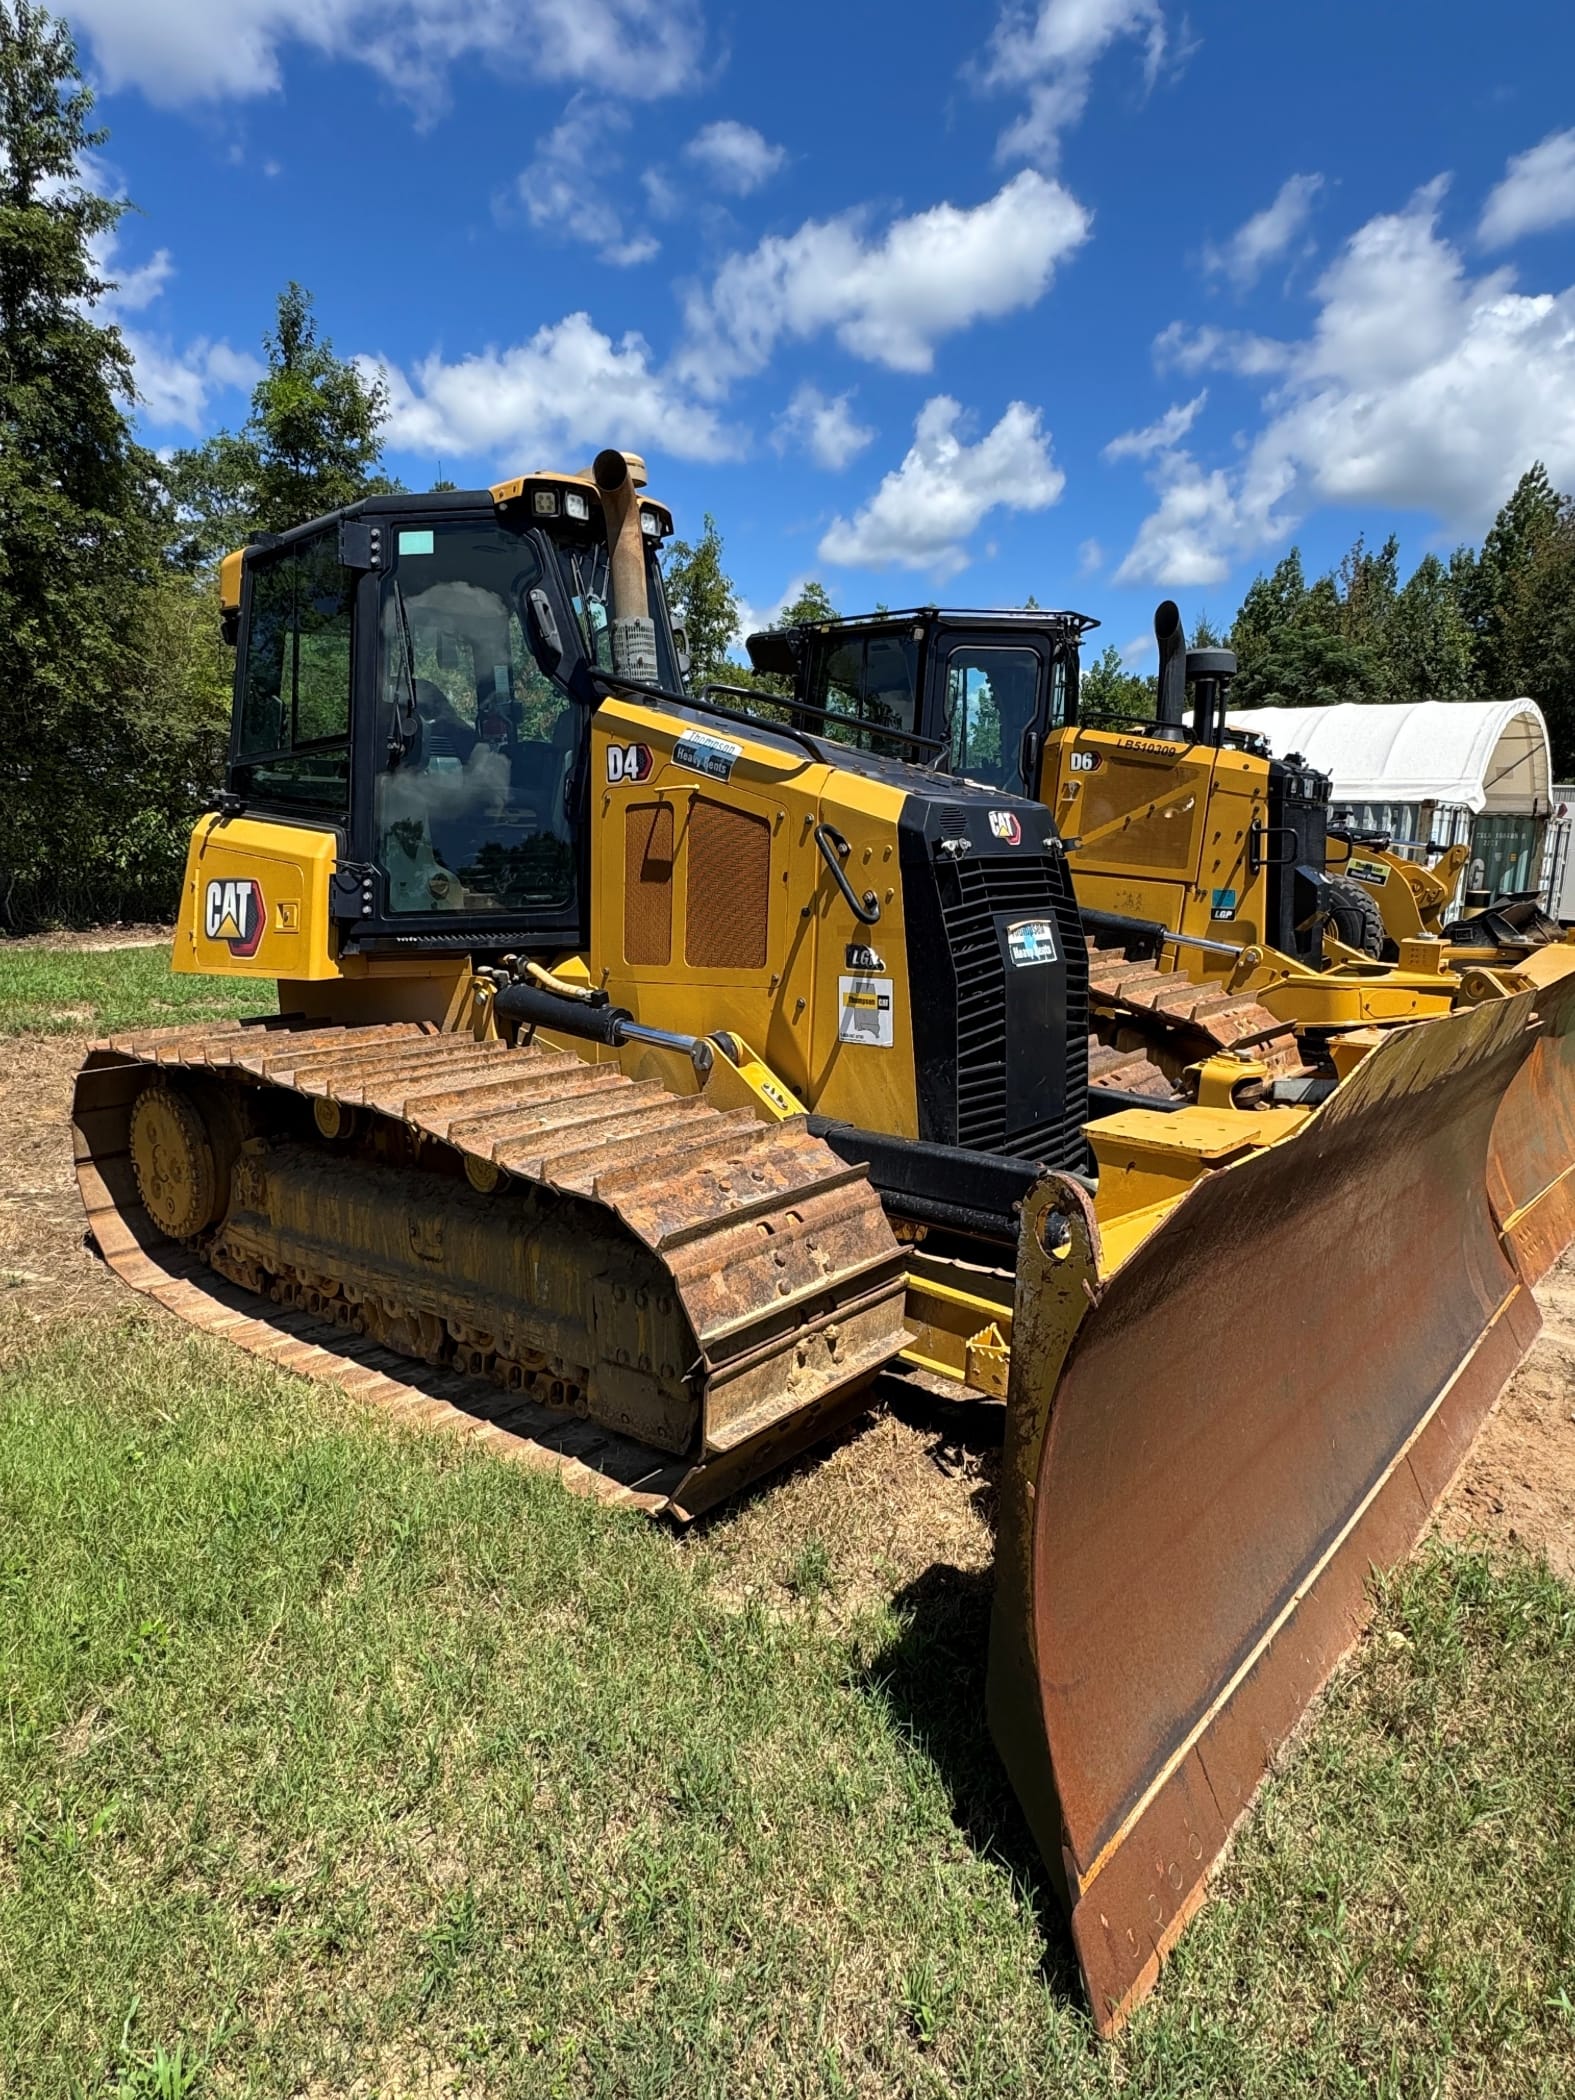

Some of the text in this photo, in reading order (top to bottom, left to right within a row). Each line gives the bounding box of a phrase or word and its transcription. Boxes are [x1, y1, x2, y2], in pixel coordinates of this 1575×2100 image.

[689, 731, 736, 754] Thompson
[1117, 739, 1176, 757] LB510309
[608, 745, 639, 780] D4
[677, 747, 727, 773] Heavy Rents
[1071, 752, 1093, 771] D6
[988, 811, 1014, 838] CAT
[206, 882, 252, 938] CAT
[1215, 910, 1232, 918] LGP
[848, 995, 876, 1006] Thompson
